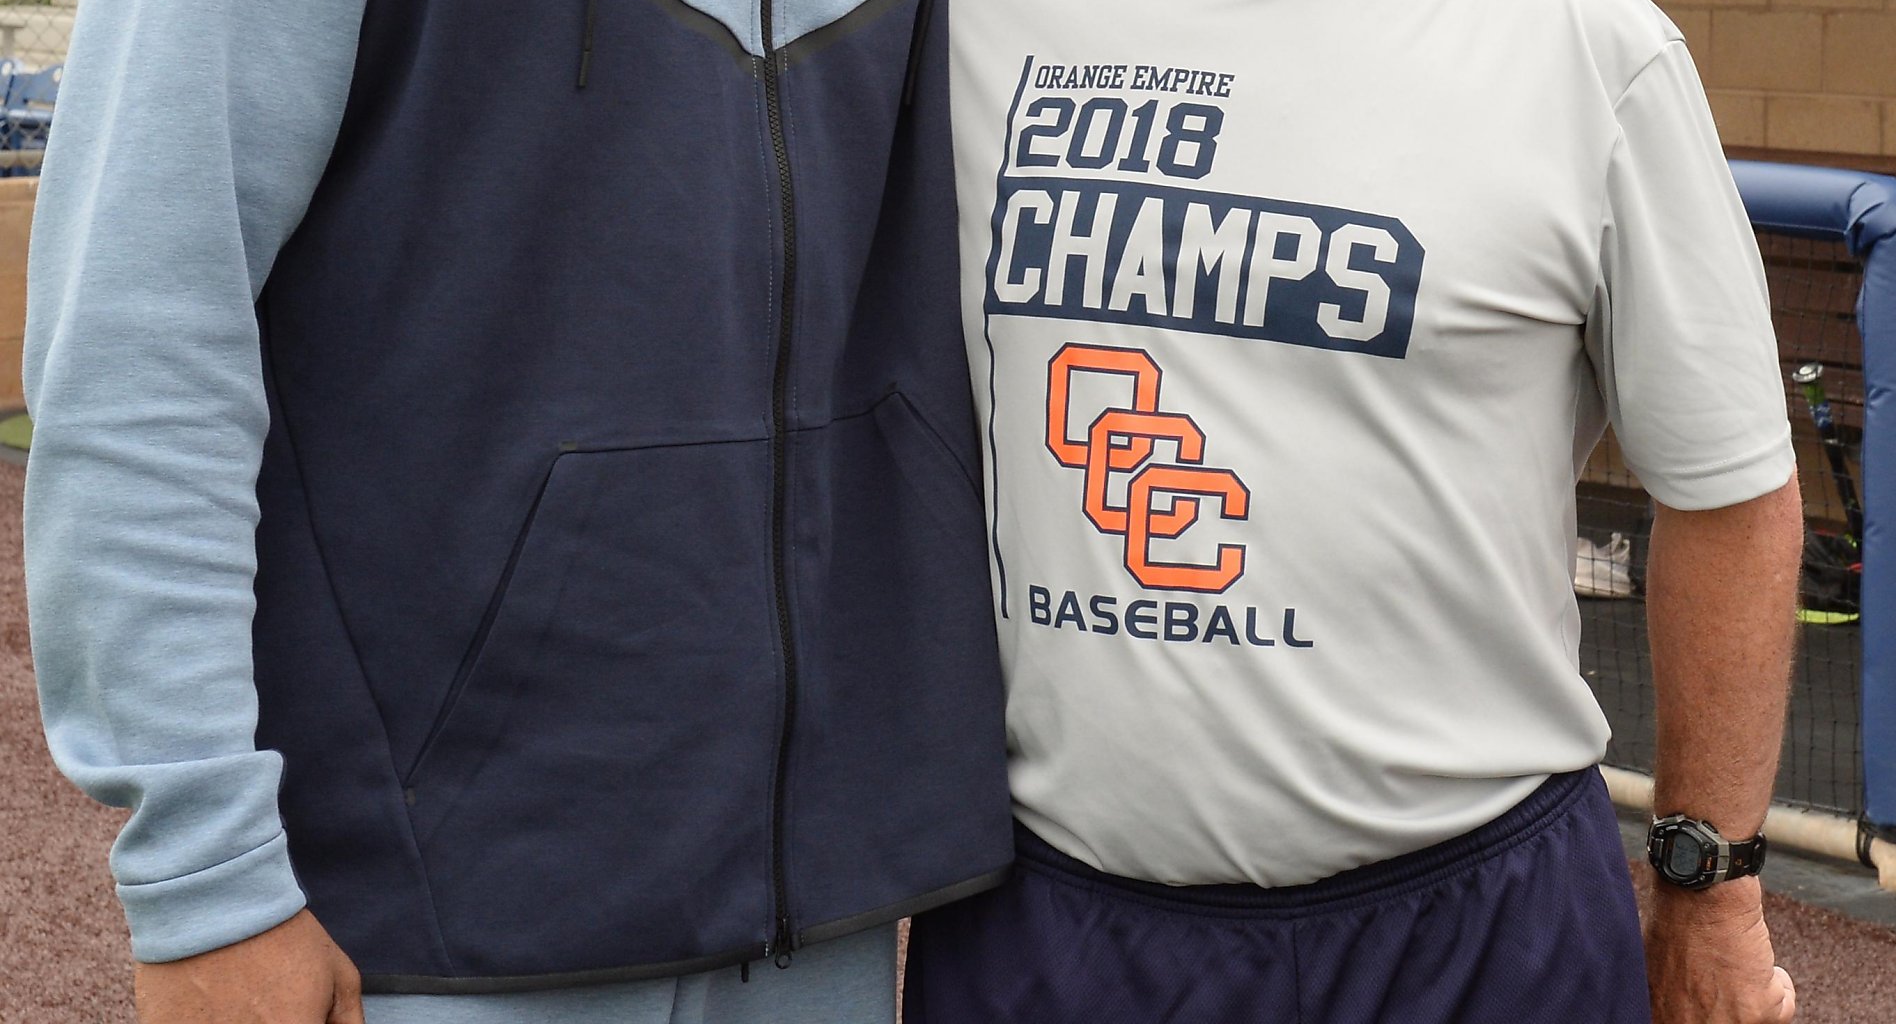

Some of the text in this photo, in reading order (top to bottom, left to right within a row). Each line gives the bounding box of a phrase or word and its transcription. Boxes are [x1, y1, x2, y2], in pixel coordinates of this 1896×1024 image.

[1034, 64, 1235, 98] ORANGE EMPIRE
[1015, 97, 1225, 180] 2018
[993, 189, 1399, 342] CHAMPS
[1028, 584, 1314, 648] BASEBALL
